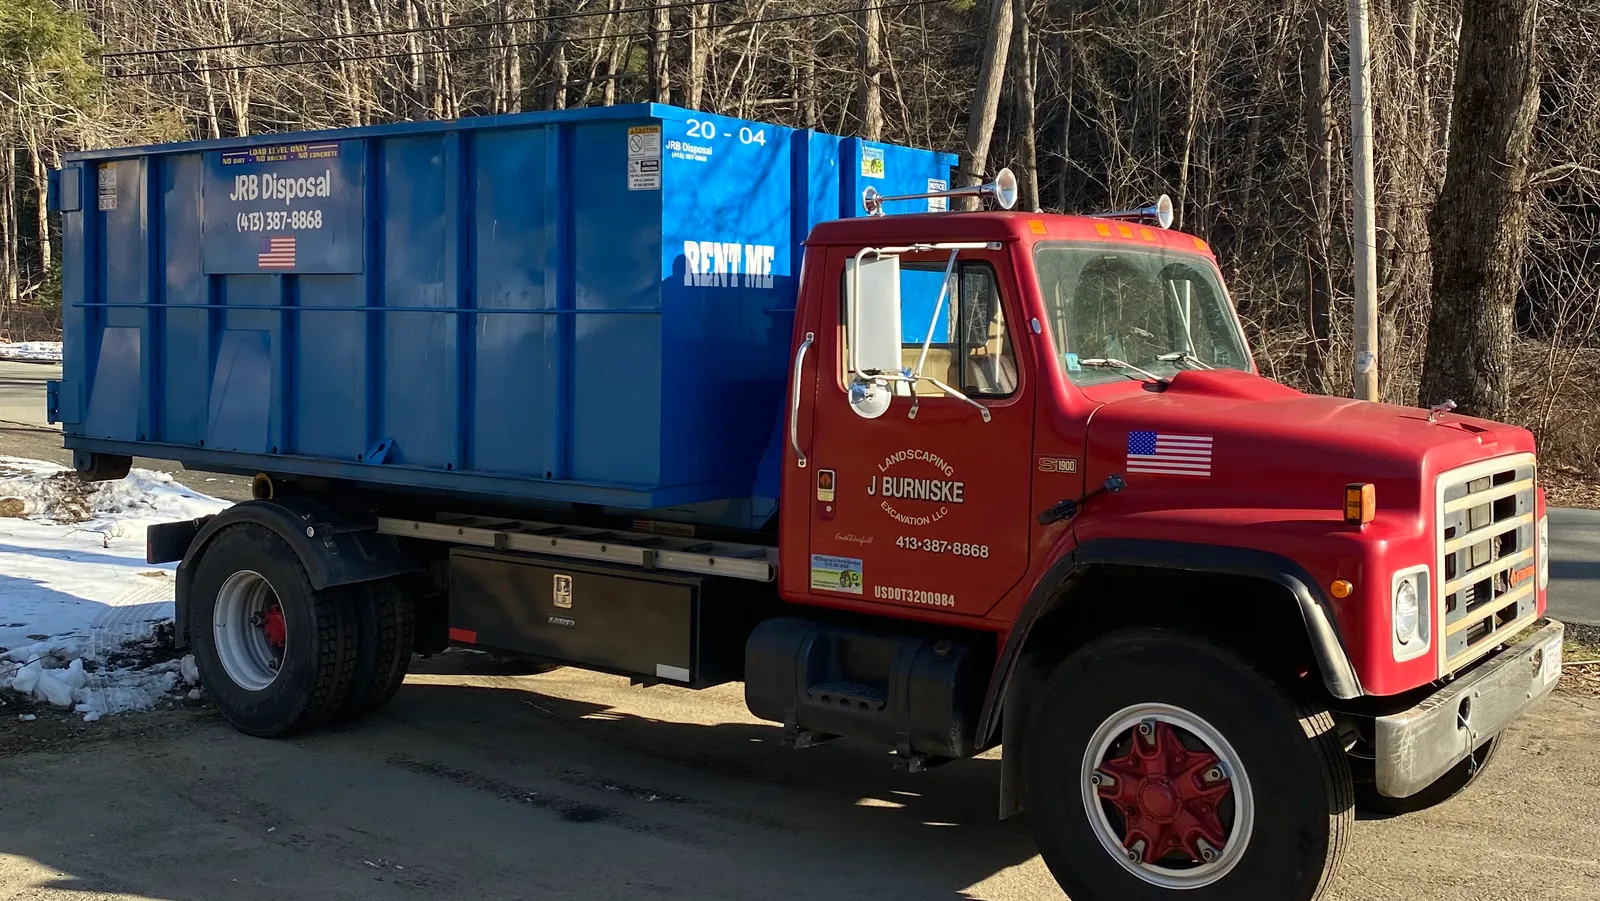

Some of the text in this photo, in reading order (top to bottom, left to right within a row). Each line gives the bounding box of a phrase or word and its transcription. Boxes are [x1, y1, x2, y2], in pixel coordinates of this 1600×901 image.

[686, 118, 716, 139] 20
[739, 126, 767, 147] 04
[222, 157, 232, 165] NO
[298, 151, 308, 159] NO
[309, 150, 338, 158] CONCRETE
[249, 144, 308, 156] LOAD LEVEL ONLY
[665, 139, 681, 151] JRB
[682, 142, 713, 156] Disposal
[229, 169, 331, 206] JRB Disposal
[236, 209, 323, 232] (413) 387-8868
[683, 240, 775, 289] RENT ME
[877, 449, 954, 478] LANDSCAPING
[867, 475, 964, 503] J BURNISKE
[880, 500, 948, 526] EXCAVATION LLC
[874, 585, 955, 607] USDOT3200984
